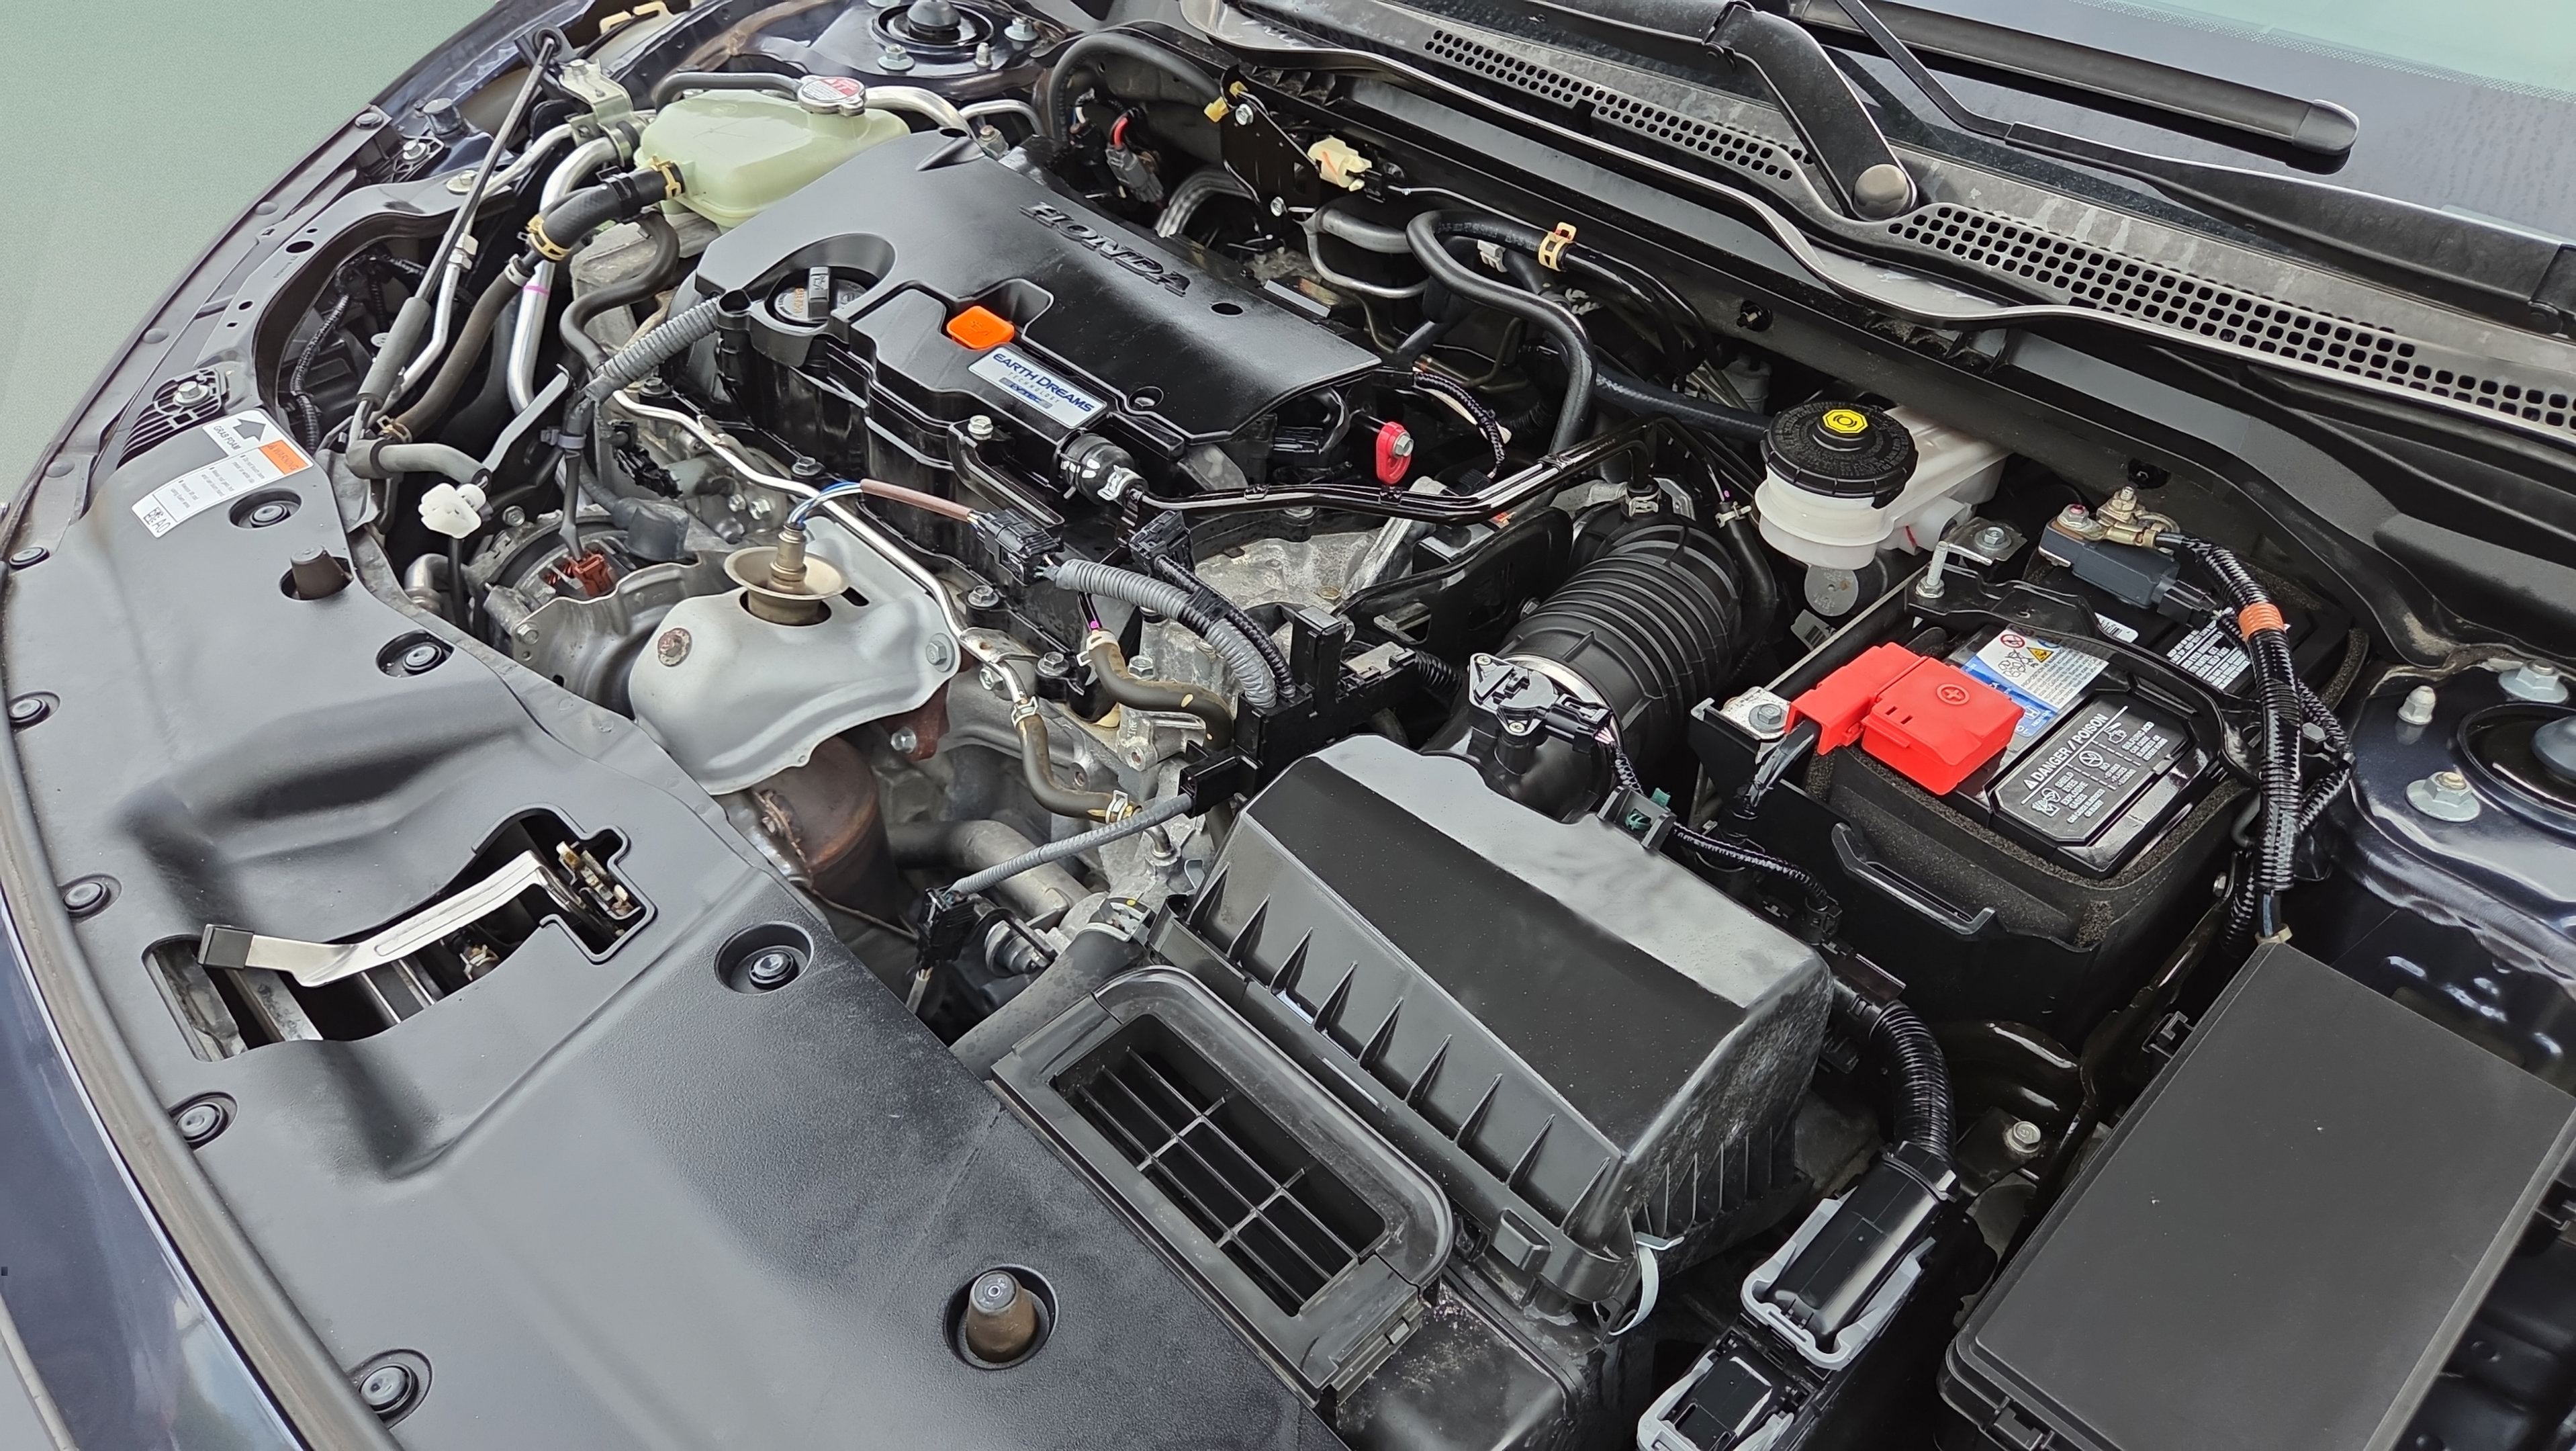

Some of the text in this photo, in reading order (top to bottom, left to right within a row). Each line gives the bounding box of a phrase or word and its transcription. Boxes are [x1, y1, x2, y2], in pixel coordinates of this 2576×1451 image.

[1018, 202, 1191, 298] HONDA
[993, 353, 1095, 412] EARTH DREAMS
[1008, 372, 1060, 404] TECHNOLOGY
[213, 425, 241, 450] GRAB FOAM
[272, 447, 299, 470] WARNING
[2120, 721, 2155, 750] SULFURIC ACID
[2054, 770, 2074, 789] SHIELD
[2060, 779, 2088, 806] EXPLOSIVE
[2062, 777, 2078, 793] EYES
